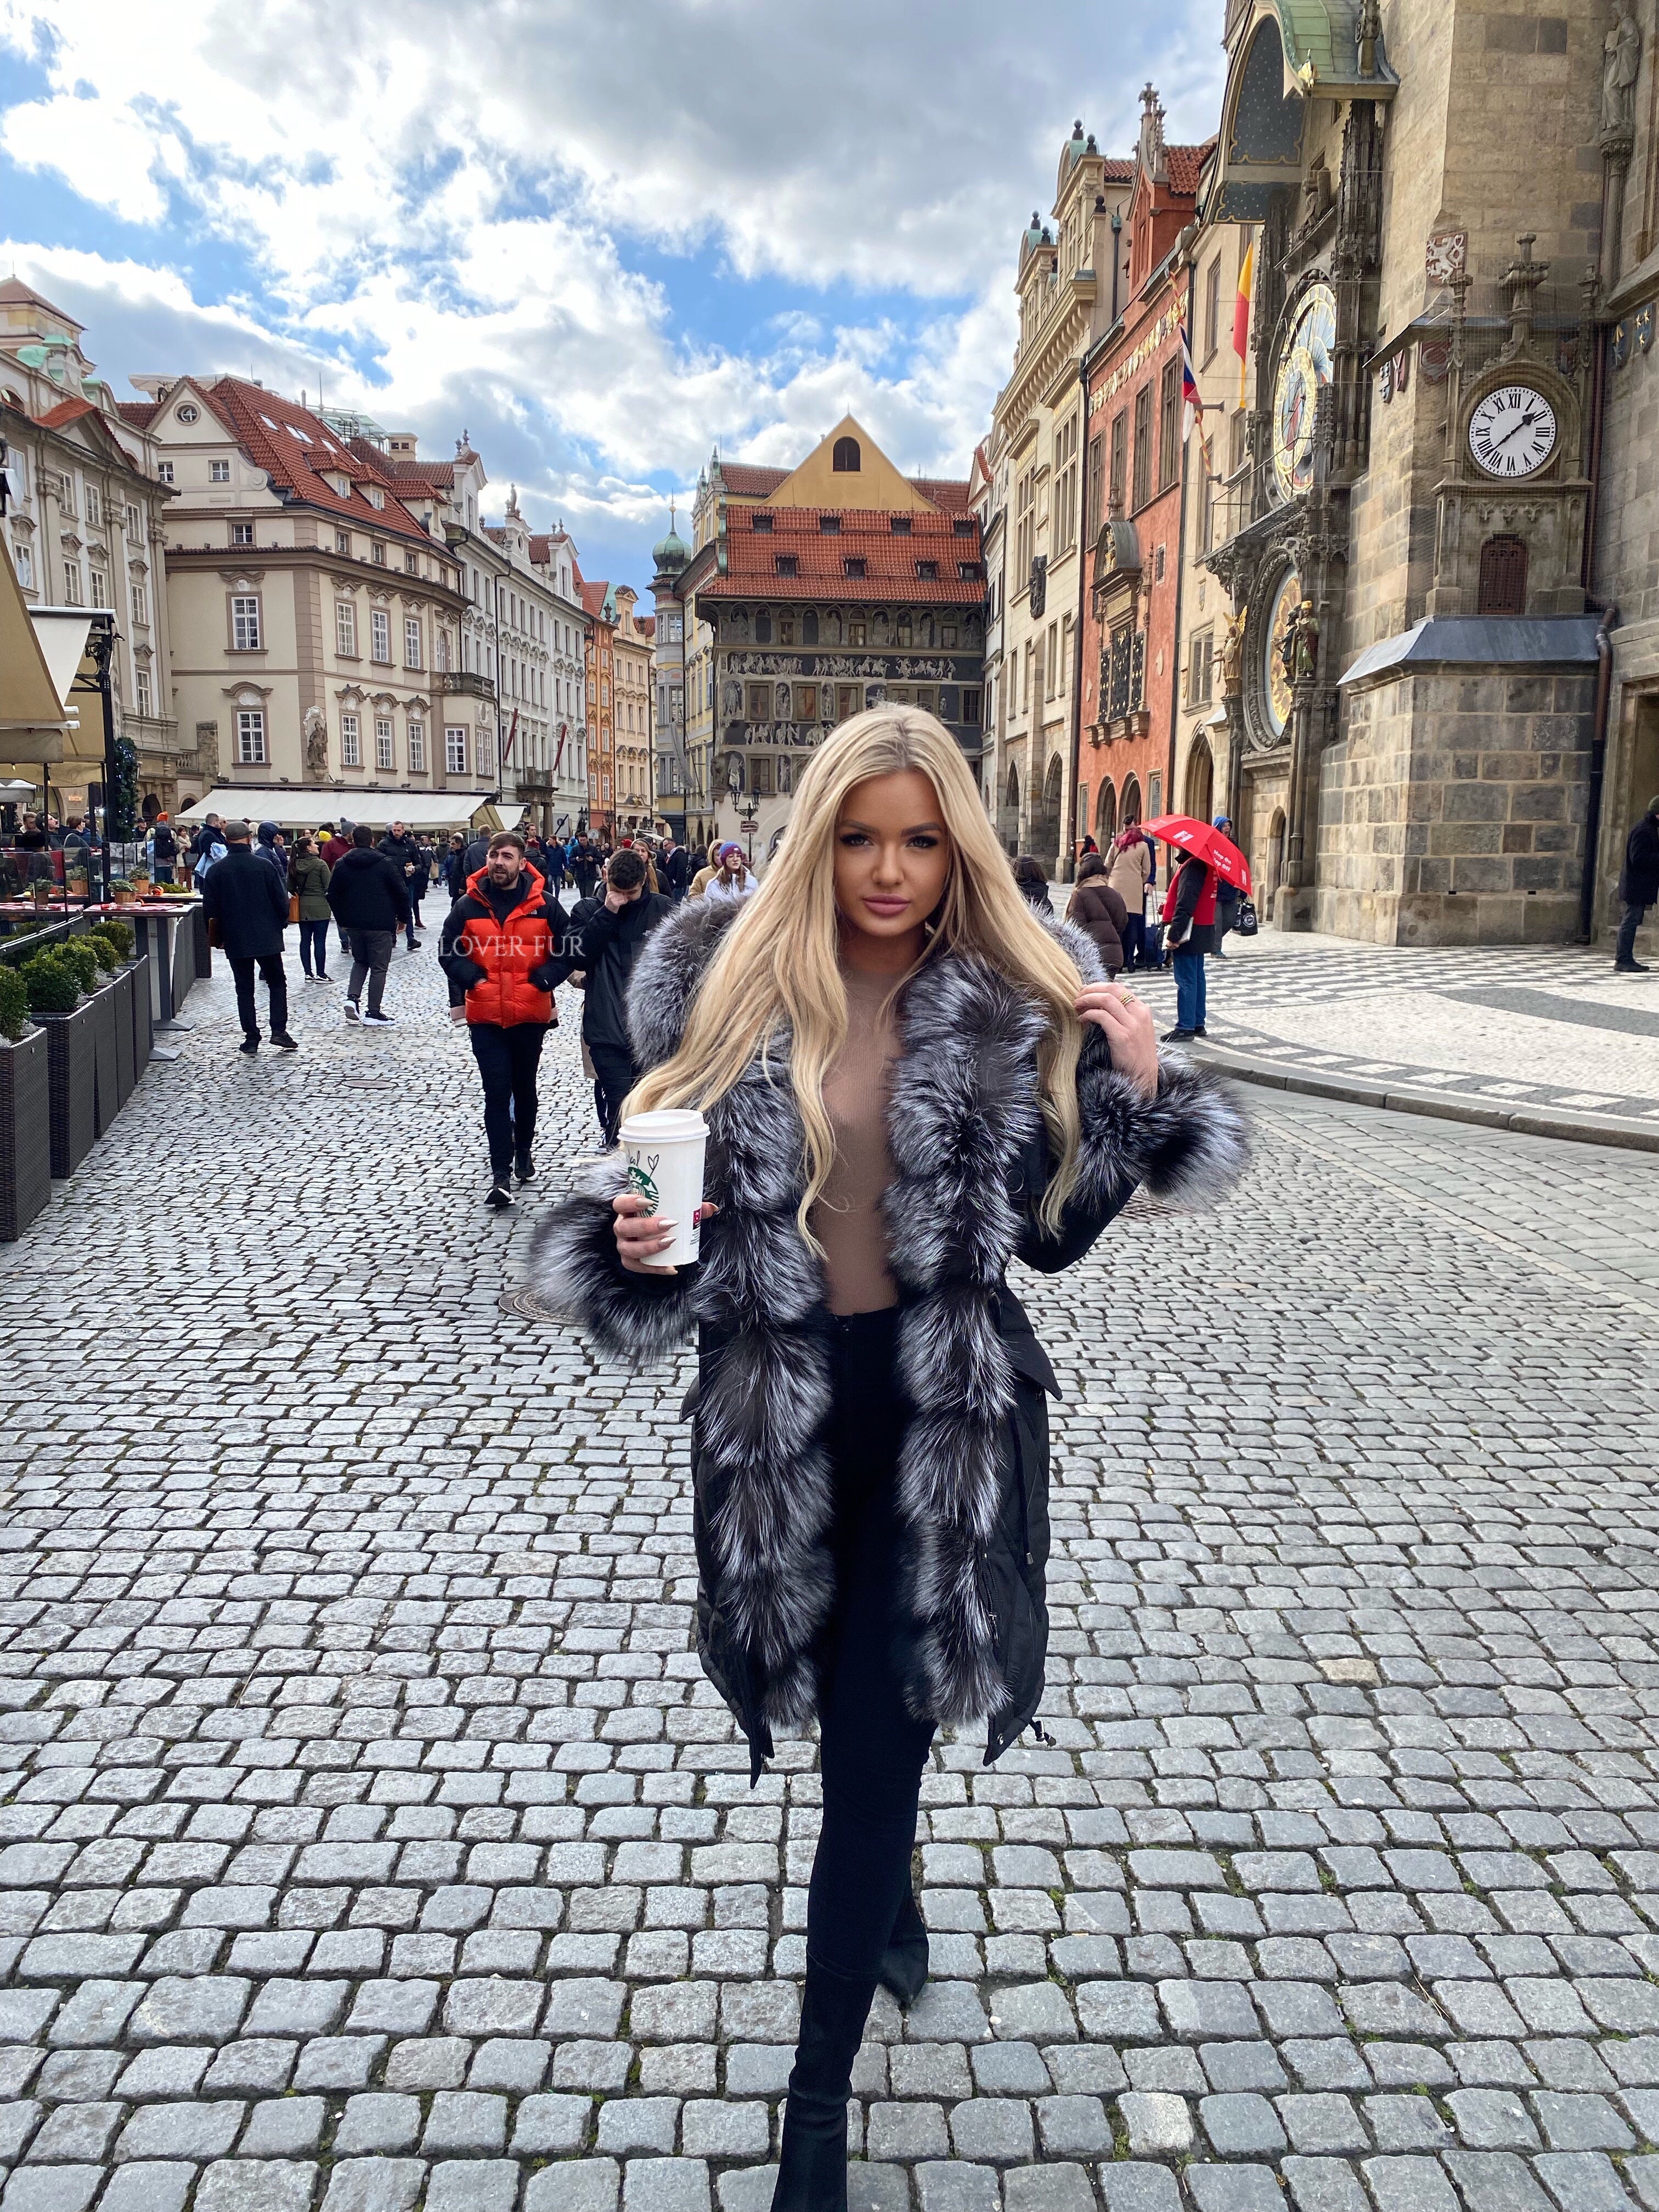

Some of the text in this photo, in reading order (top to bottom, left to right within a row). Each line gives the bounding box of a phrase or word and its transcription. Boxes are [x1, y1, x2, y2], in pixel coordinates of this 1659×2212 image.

[1508, 393, 1521, 409] XII
[1480, 410, 1496, 422] X
[1535, 427, 1550, 437] III
